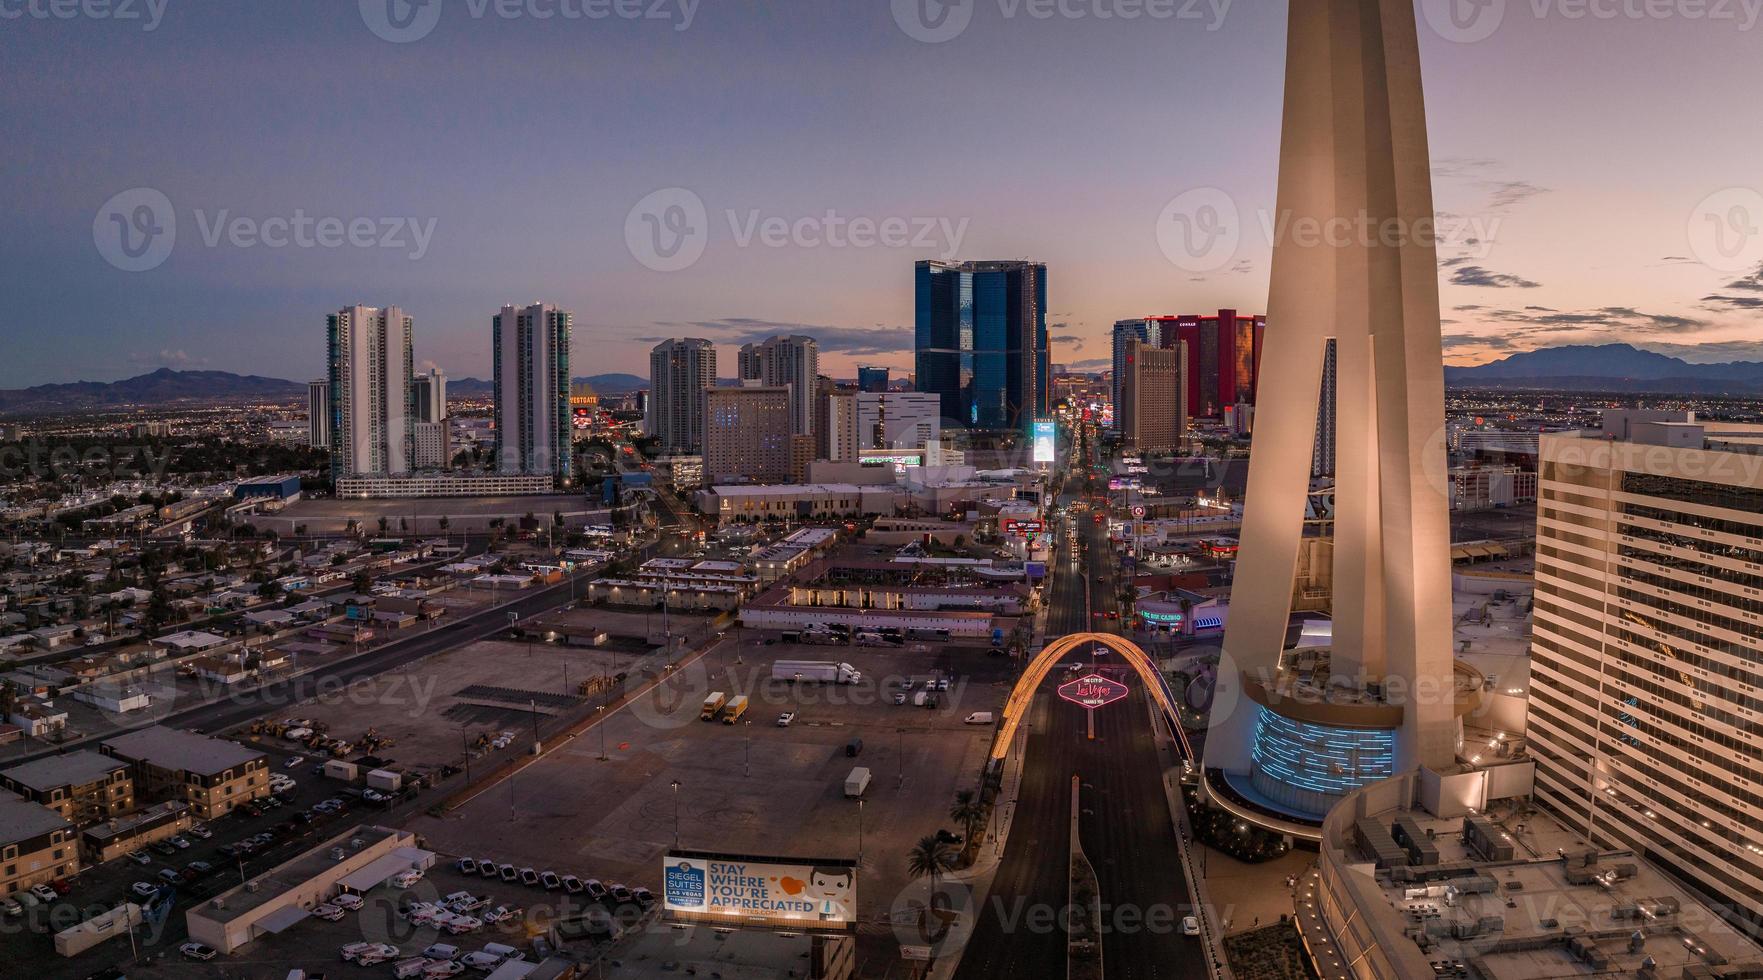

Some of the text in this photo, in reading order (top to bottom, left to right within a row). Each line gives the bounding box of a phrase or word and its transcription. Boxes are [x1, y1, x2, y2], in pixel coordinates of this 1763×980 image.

[1076, 683, 1111, 700] Las Vegas
[710, 863, 746, 875] STAY
[668, 872, 702, 882] SIEGEL
[711, 874, 765, 888] WHERE
[668, 880, 702, 890] SUITES
[710, 885, 769, 899] YOU'RE
[709, 905, 778, 916] SIEGUITES.COM
[710, 896, 814, 913] APPRECIATED
